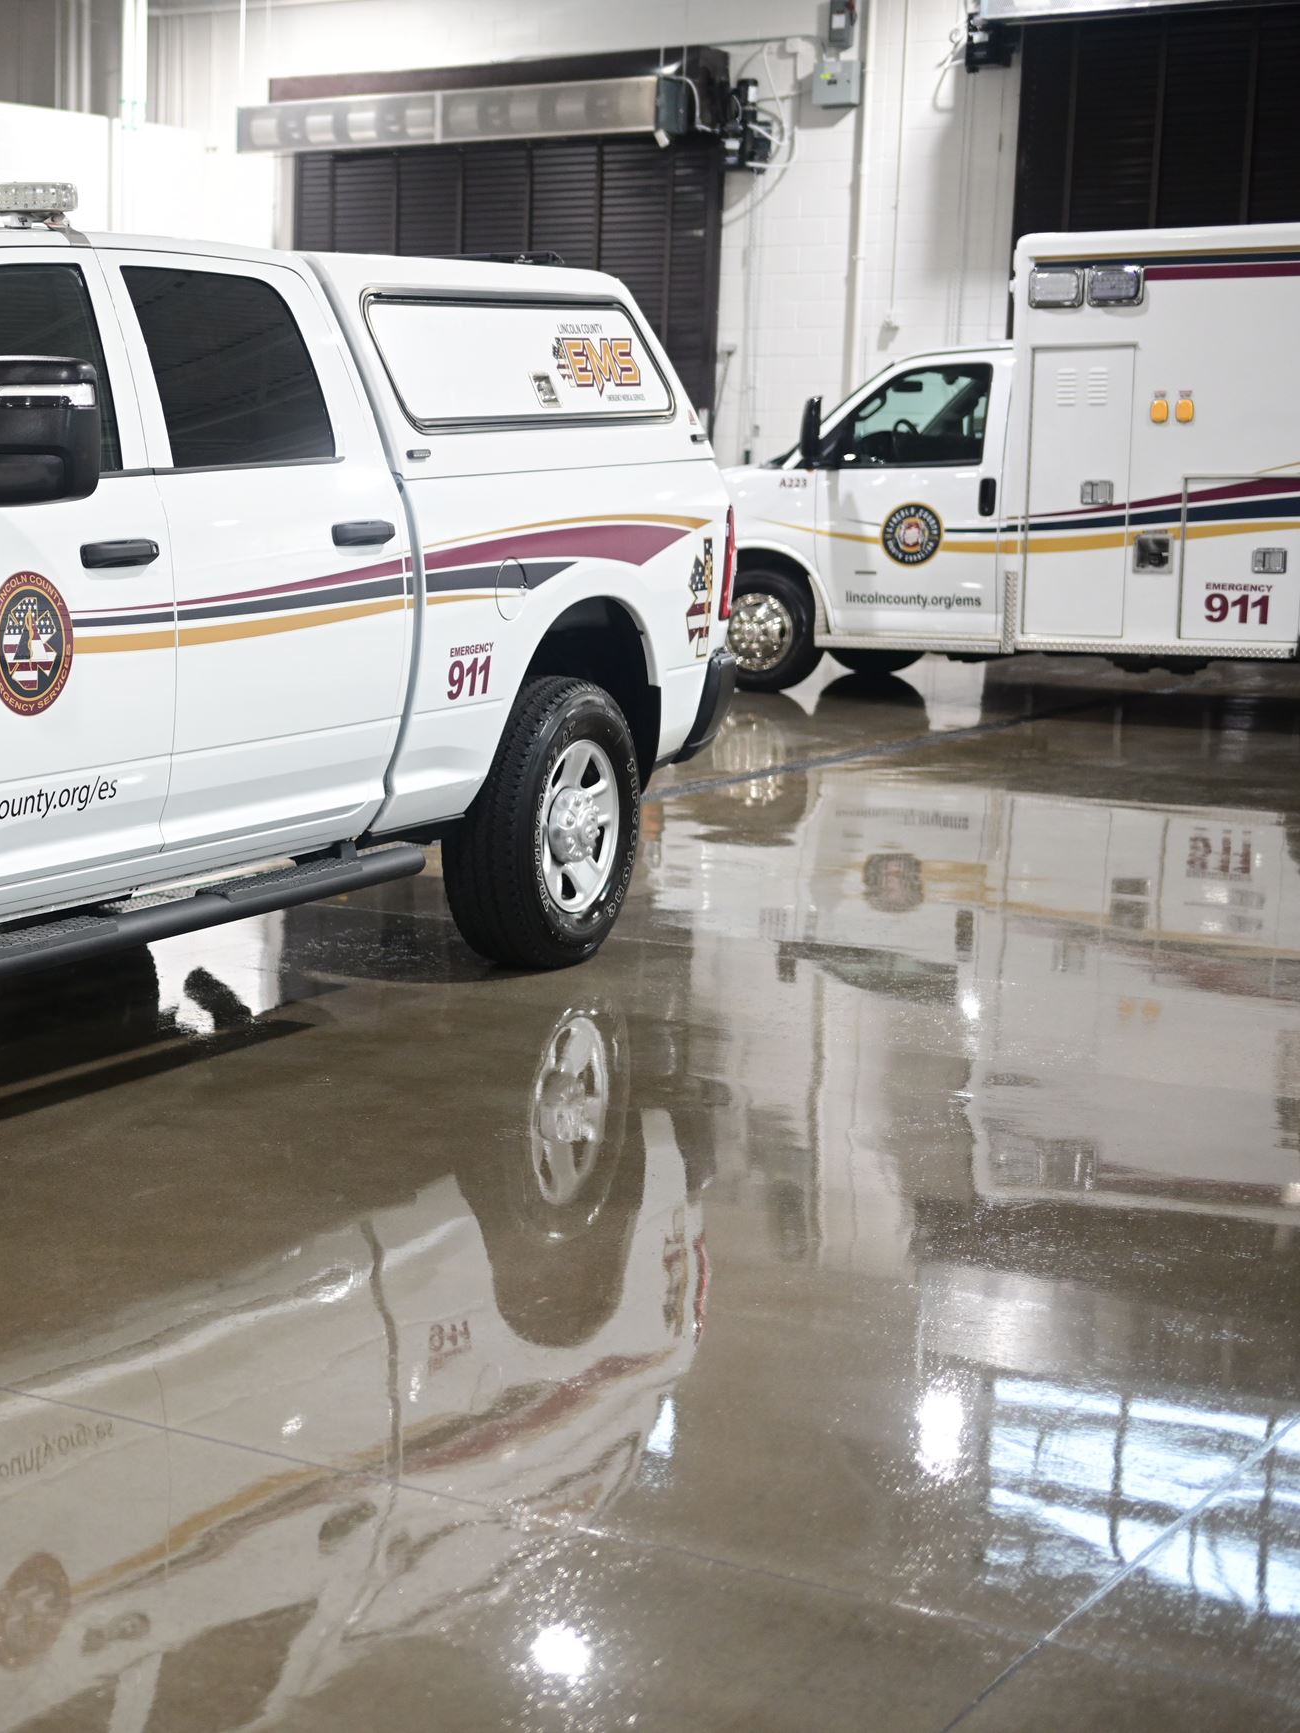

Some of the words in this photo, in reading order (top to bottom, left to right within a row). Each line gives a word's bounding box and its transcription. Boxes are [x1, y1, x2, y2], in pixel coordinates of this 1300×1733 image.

[580, 323, 604, 334] COUNTY
[560, 337, 642, 398] EMS
[28, 574, 65, 607] COUNTY
[844, 590, 983, 610] lincolncounty.org/ems
[1204, 582, 1273, 593] EMERGENCY
[1204, 592, 1270, 625] 911
[449, 641, 495, 658] EMERGENCY
[37, 643, 73, 710] SERVICES
[446, 655, 492, 701] 911
